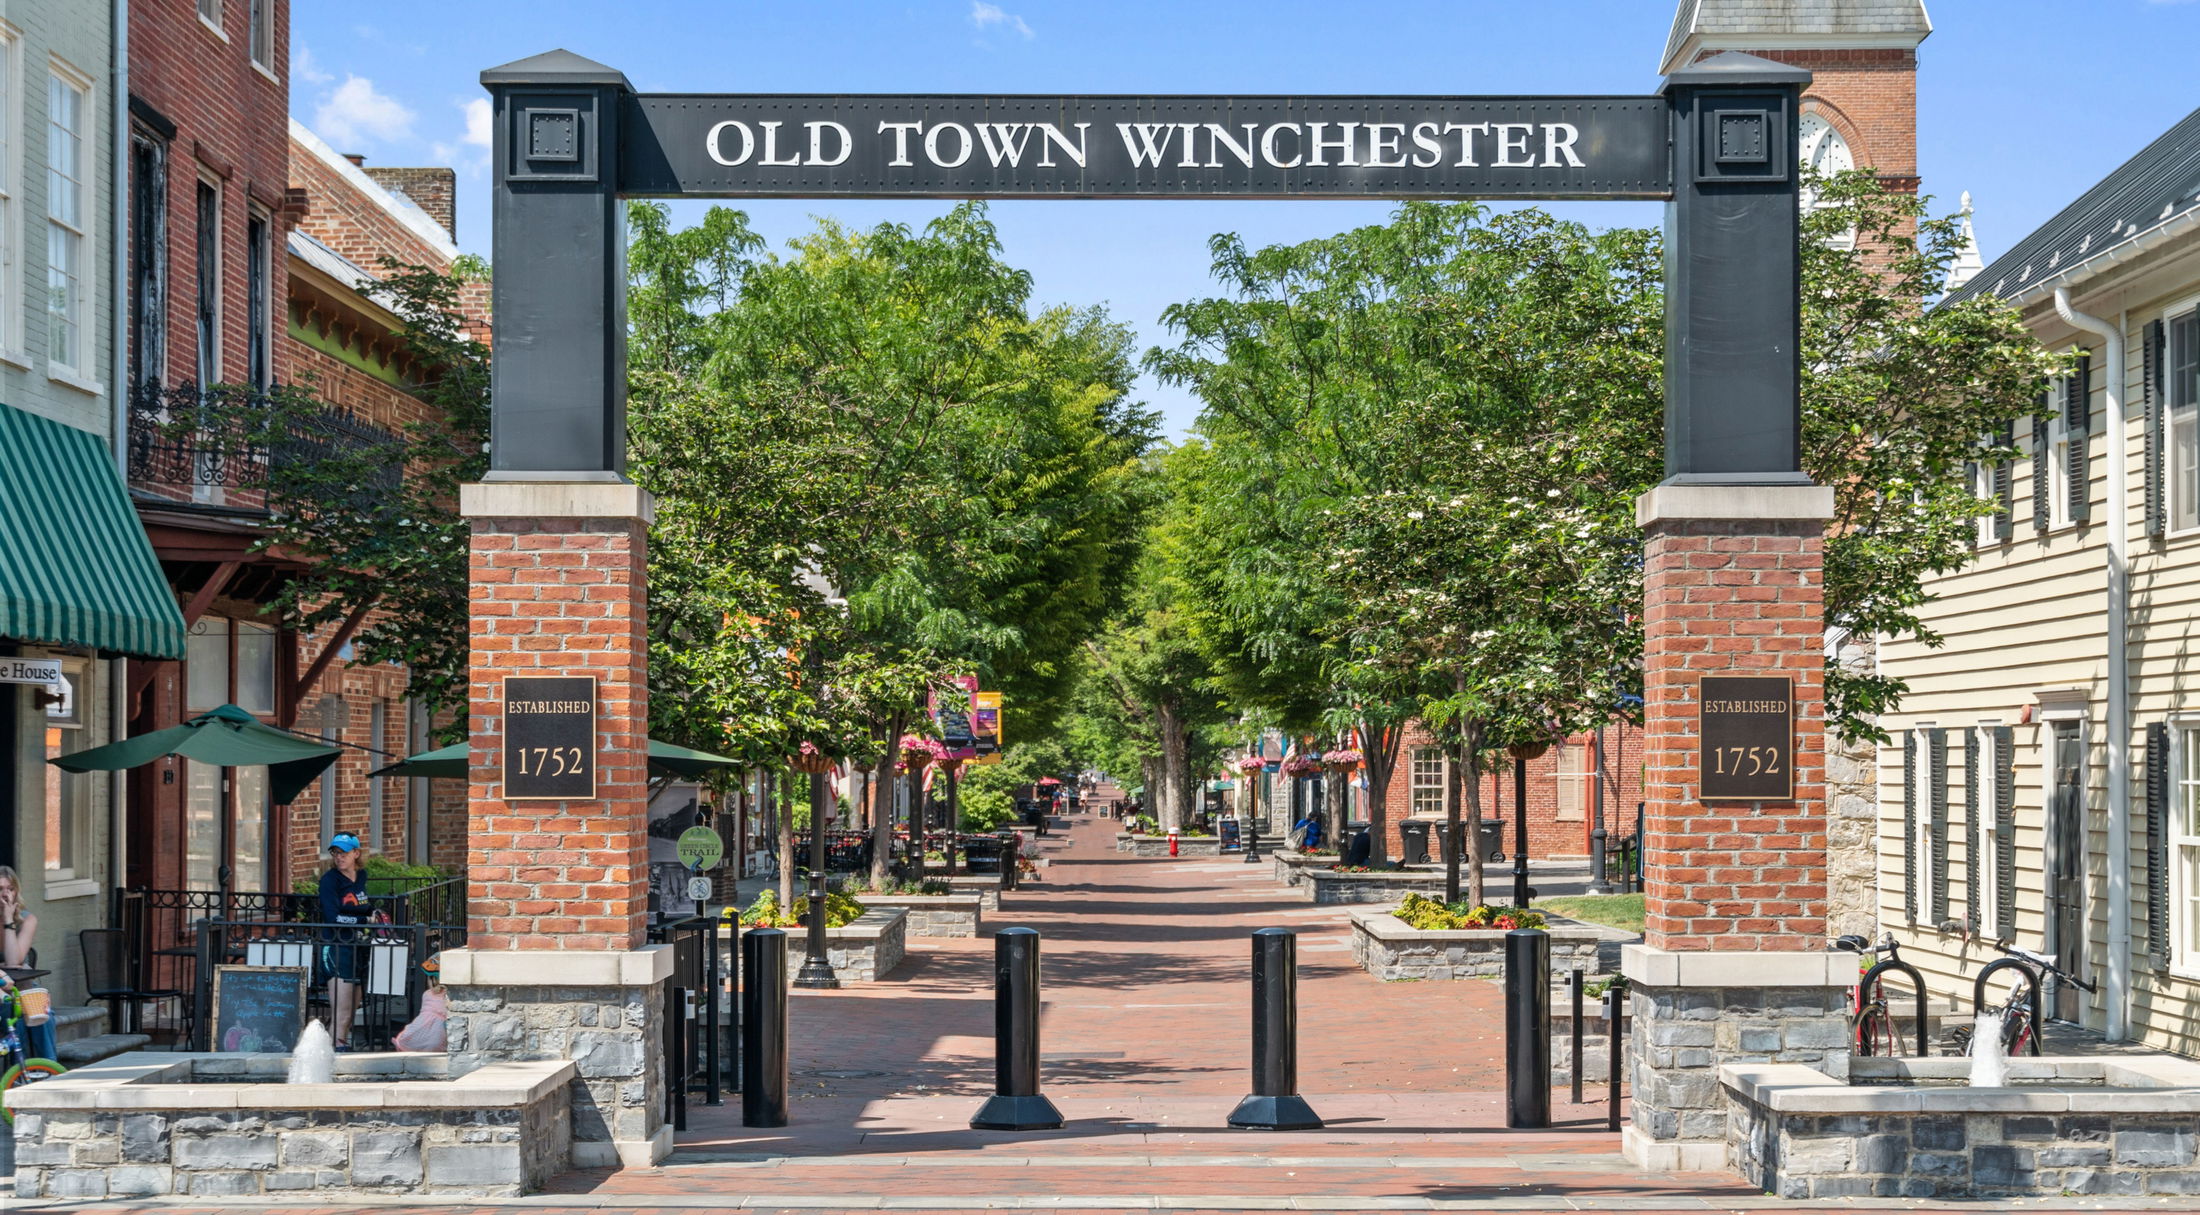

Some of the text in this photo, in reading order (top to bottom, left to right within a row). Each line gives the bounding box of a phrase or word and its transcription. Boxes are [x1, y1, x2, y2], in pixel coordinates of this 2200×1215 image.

[705, 119, 1587, 170] OLD TOWN WINCHESTER
[12, 662, 57, 680] House
[508, 700, 591, 714] ESTABLISHED
[1704, 700, 1787, 714] ESTABLISHED
[518, 746, 584, 777] 1752
[1714, 746, 1780, 777] 1752
[680, 848, 720, 856] TRAIL
